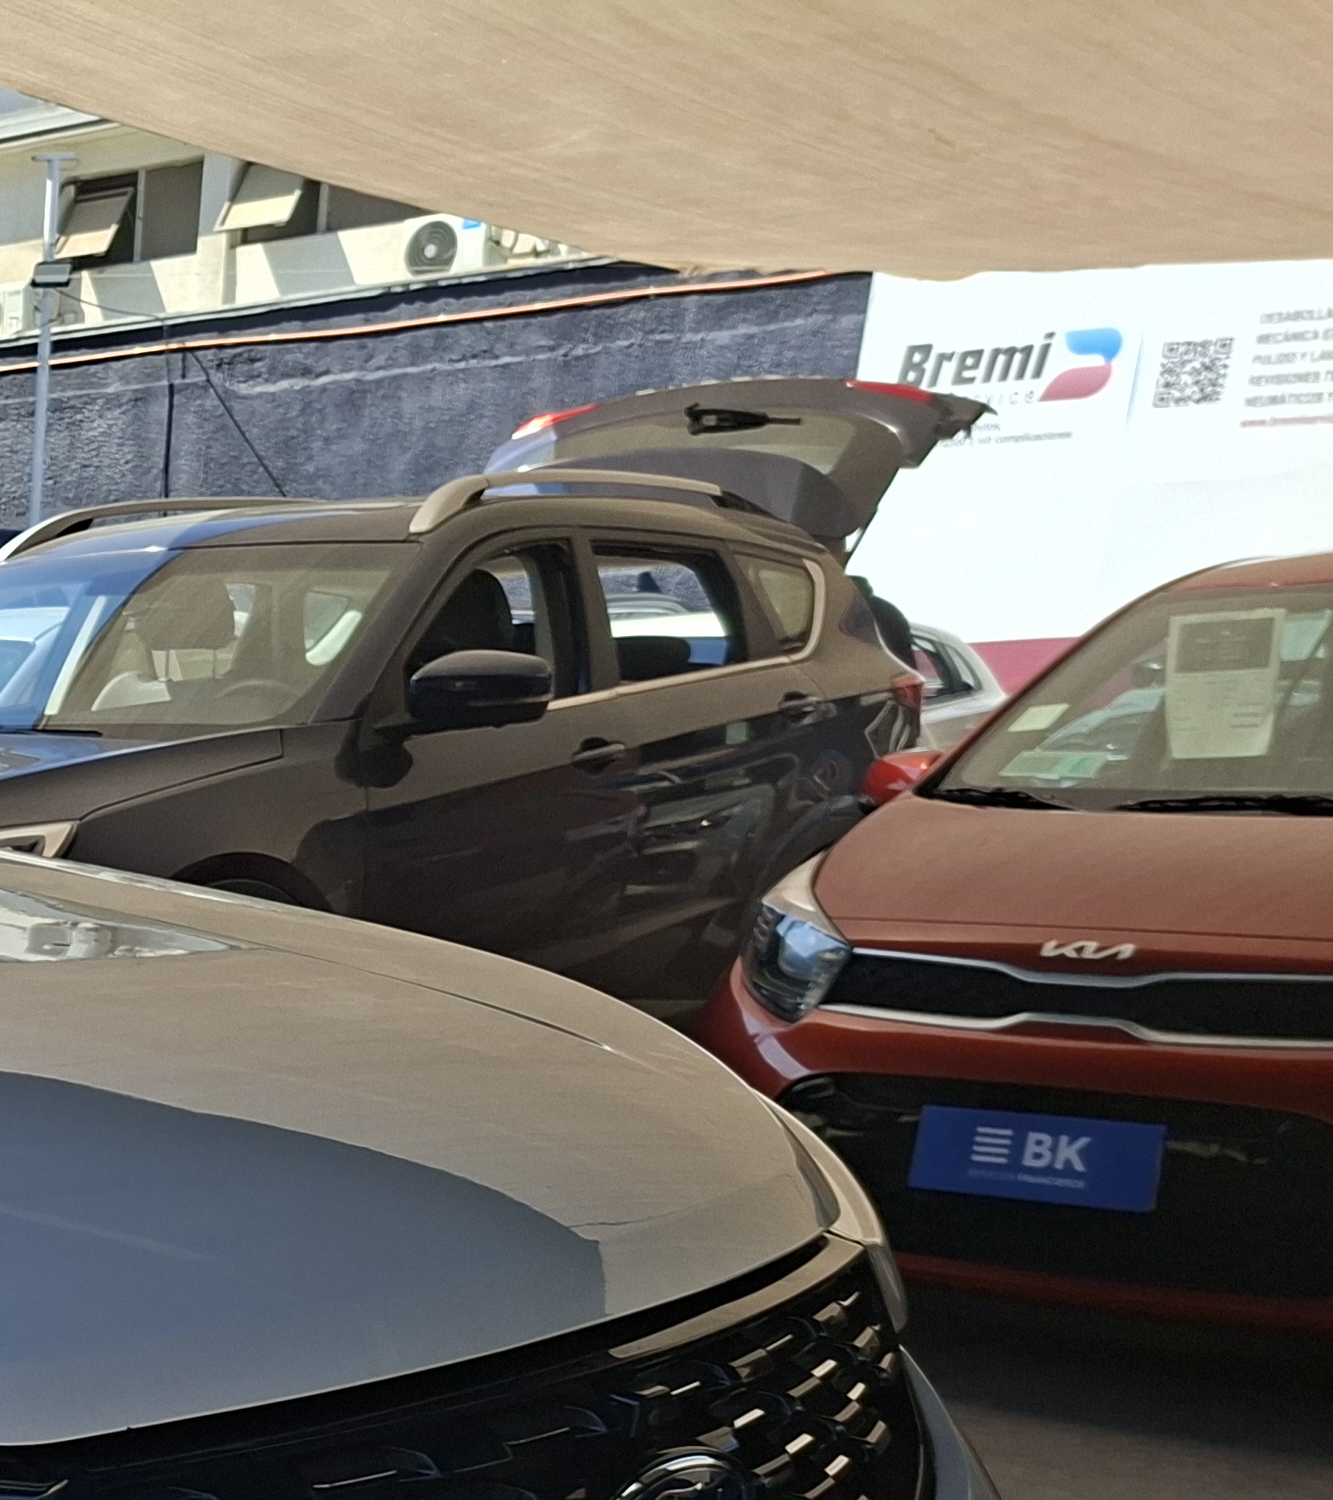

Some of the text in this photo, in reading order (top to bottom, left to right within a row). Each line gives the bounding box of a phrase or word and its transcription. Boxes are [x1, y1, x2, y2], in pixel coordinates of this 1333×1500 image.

[897, 330, 1057, 388] Bremi
[1039, 939, 1137, 961] KIA
[1021, 1130, 1093, 1173] BK
